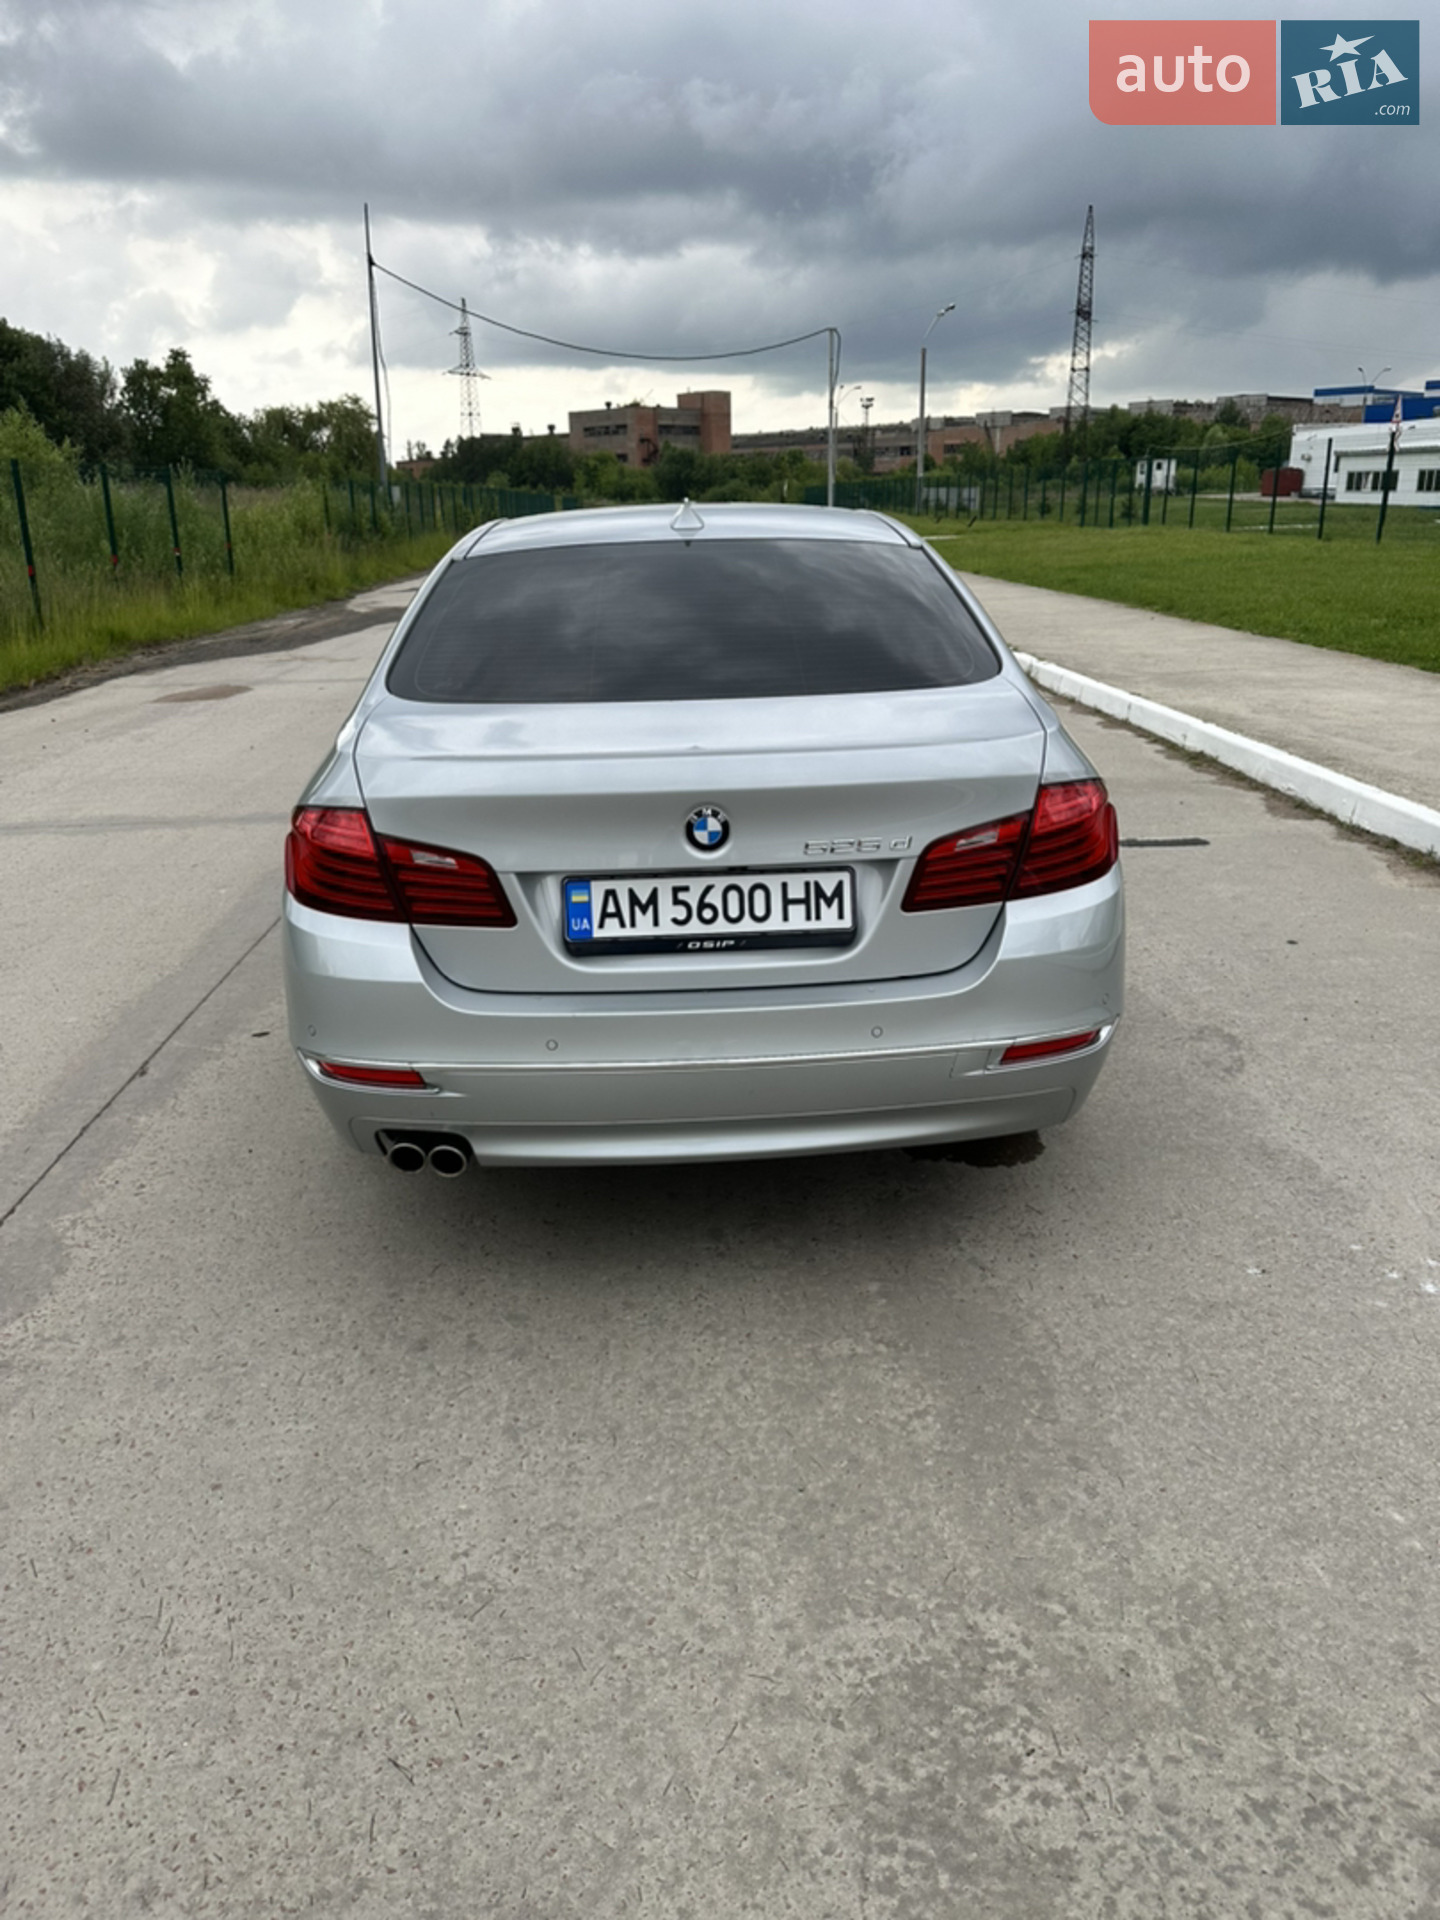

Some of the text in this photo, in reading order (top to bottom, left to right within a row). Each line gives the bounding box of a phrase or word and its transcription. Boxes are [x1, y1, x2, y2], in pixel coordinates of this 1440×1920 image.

[598, 879, 845, 929] AM 5600 HM
[571, 918, 591, 932] UA
